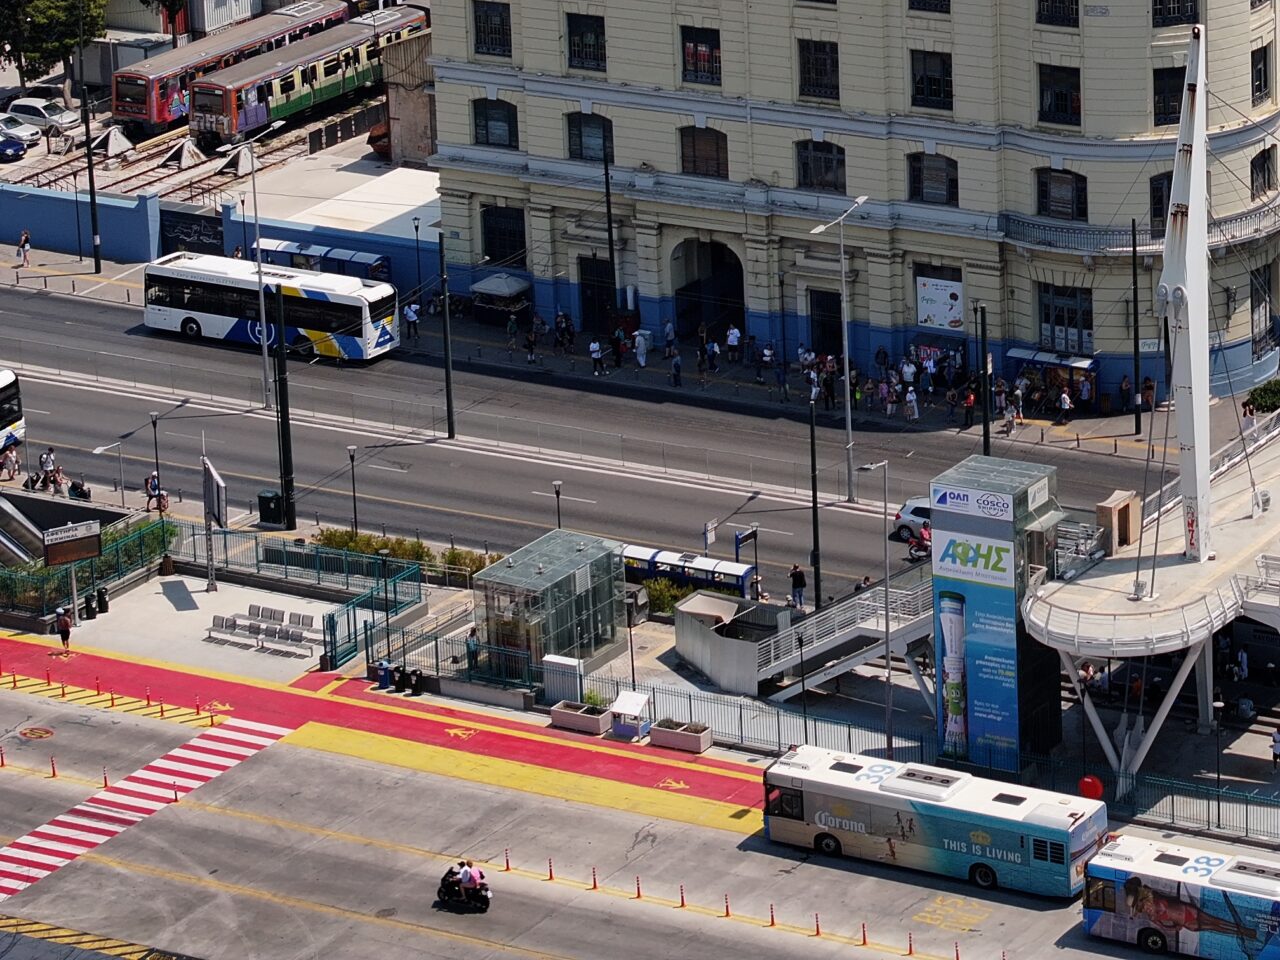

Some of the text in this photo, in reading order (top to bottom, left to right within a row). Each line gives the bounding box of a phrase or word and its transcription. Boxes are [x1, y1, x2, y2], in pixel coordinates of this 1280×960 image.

[948, 491, 969, 502] ΟΛΠ
[976, 498, 1009, 509] COSCO
[46, 533, 79, 544] TERMINAL
[939, 538, 1011, 573] ΑΦΗΣ
[814, 809, 866, 835] Corona
[943, 839, 1022, 864] THIS IS LIVING
